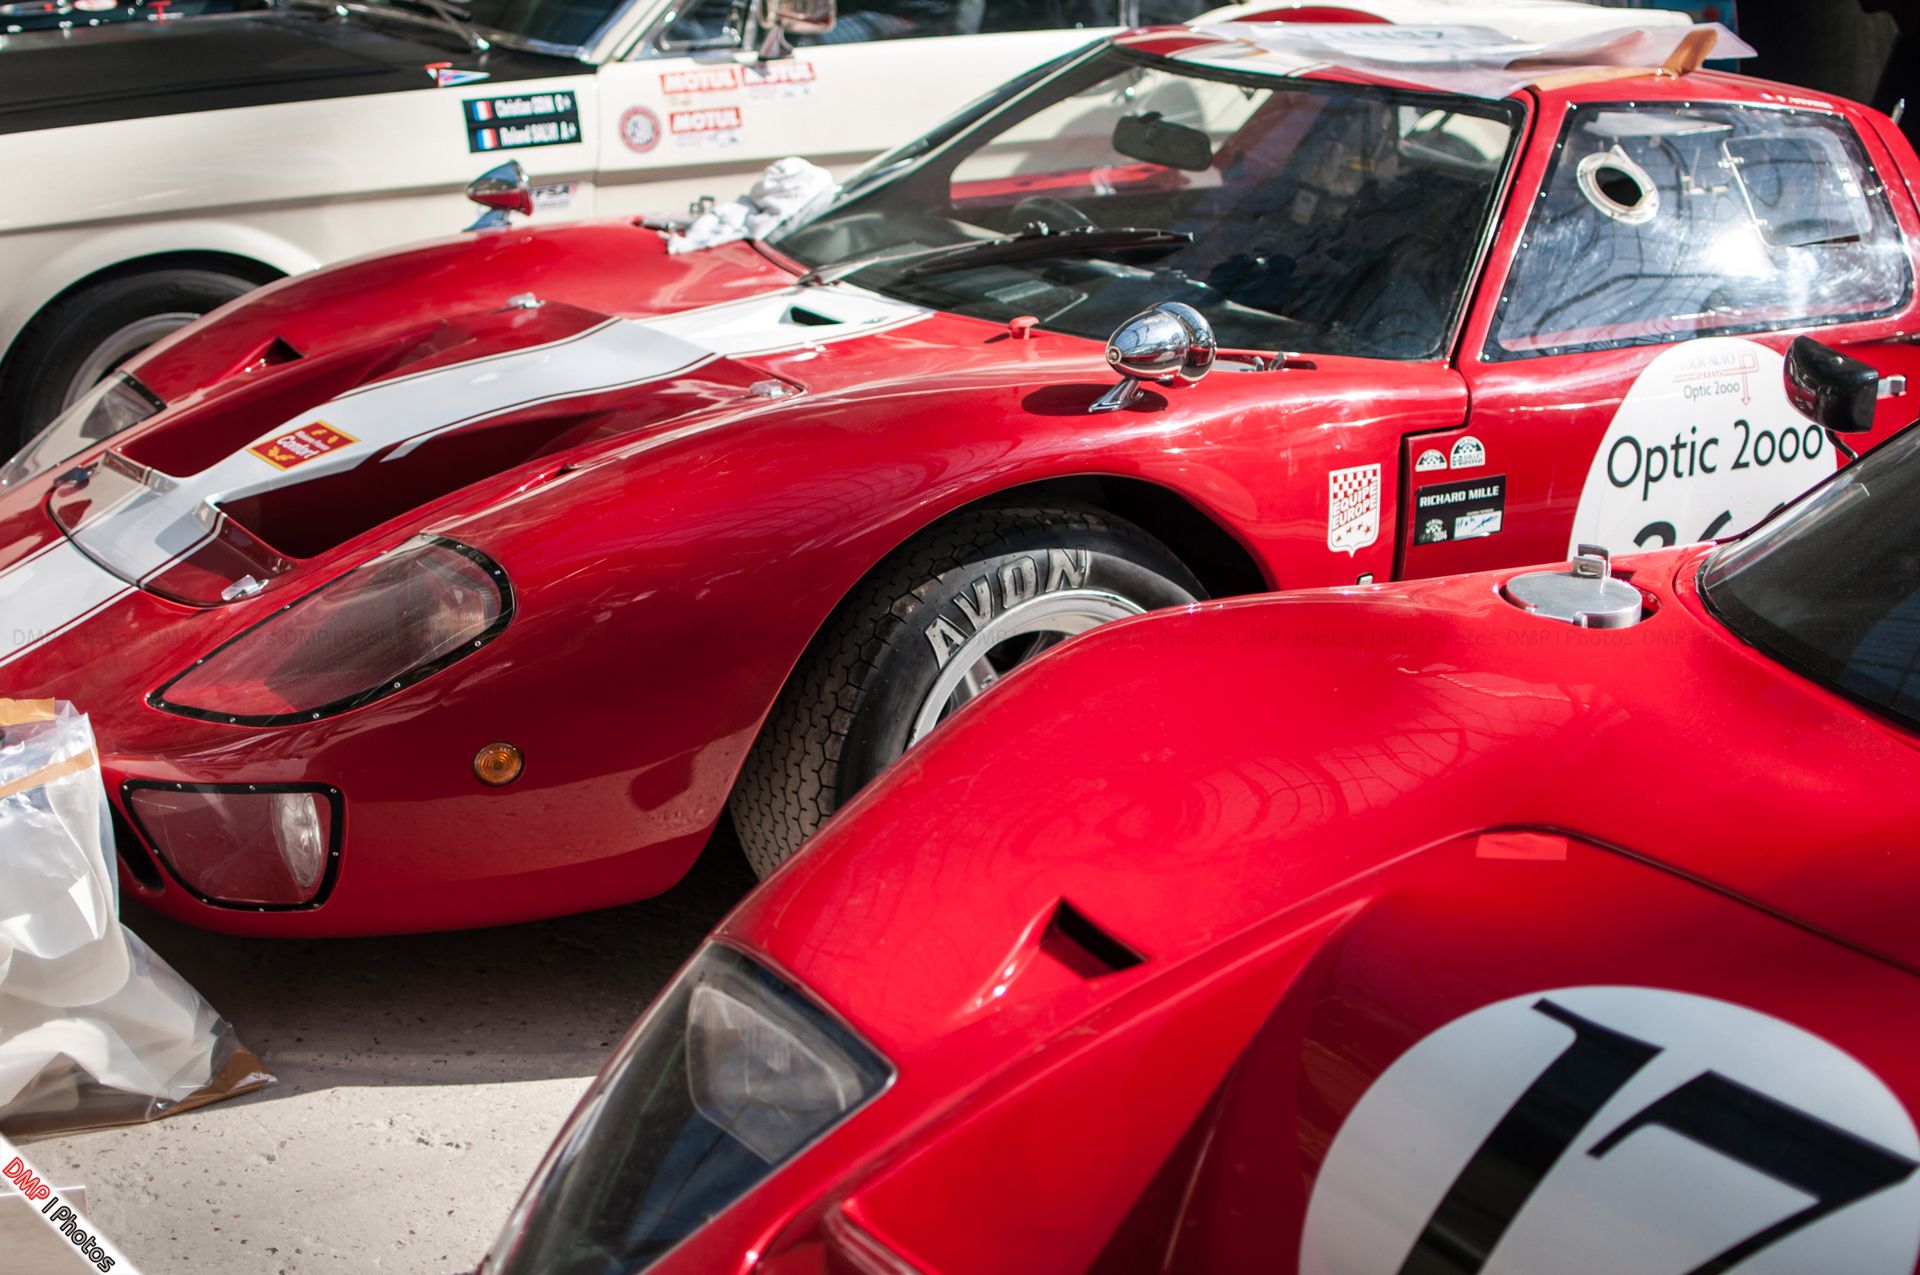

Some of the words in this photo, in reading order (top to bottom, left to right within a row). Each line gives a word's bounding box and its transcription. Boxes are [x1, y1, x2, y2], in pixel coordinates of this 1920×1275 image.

[664, 69, 735, 92] MOTUL
[674, 108, 737, 131] MOTUL
[1683, 384, 1712, 402] Optic
[1714, 380, 1740, 395] 2000
[276, 435, 320, 459] Confort
[1607, 426, 1720, 502] Optic
[1730, 419, 1823, 471] 2000
[1332, 480, 1378, 516] EQUIPE
[1420, 490, 1467, 508] RICHARD
[1468, 485, 1500, 500] MILLE
[1332, 495, 1378, 530] EUROPE
[925, 546, 1088, 670] AVON
